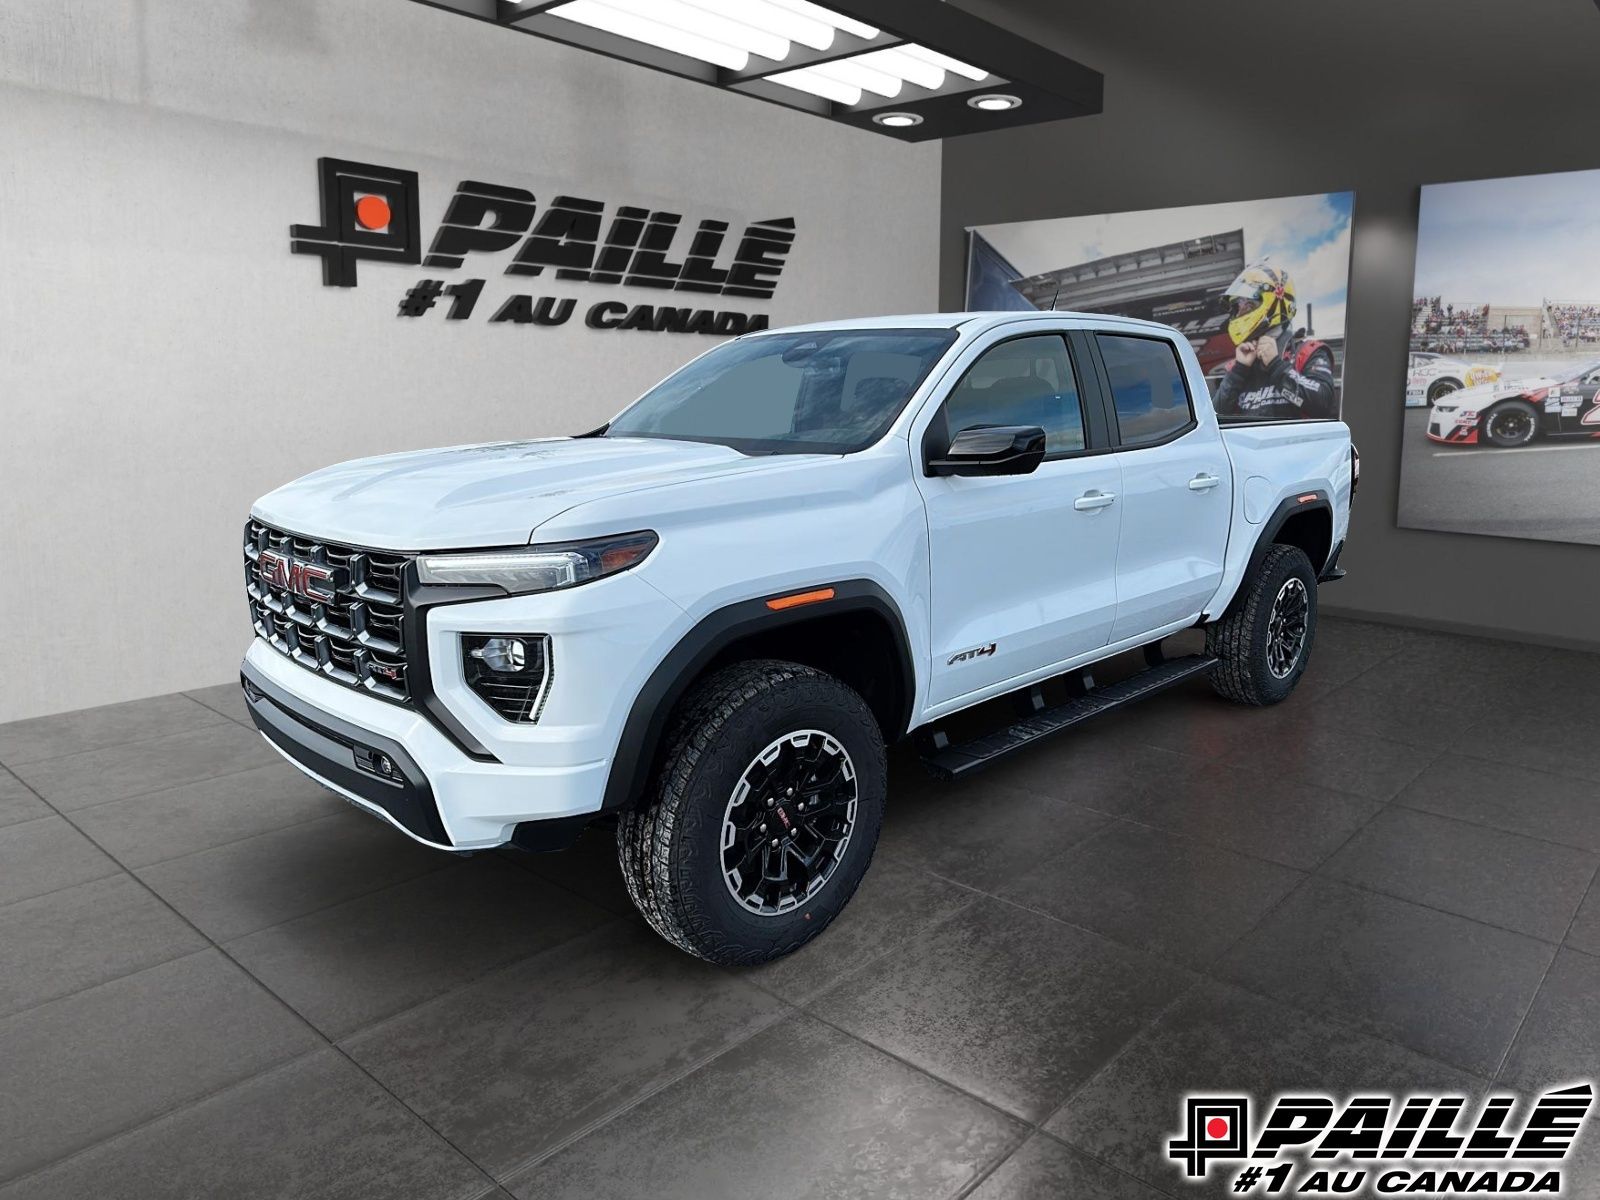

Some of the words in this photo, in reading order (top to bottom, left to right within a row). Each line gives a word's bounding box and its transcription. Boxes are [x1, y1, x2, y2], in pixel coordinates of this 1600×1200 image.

[422, 180, 796, 299] PAILLÉ
[397, 279, 487, 320] #1
[488, 294, 578, 327] AU
[585, 300, 769, 336] CANADA
[259, 549, 335, 605] GMC
